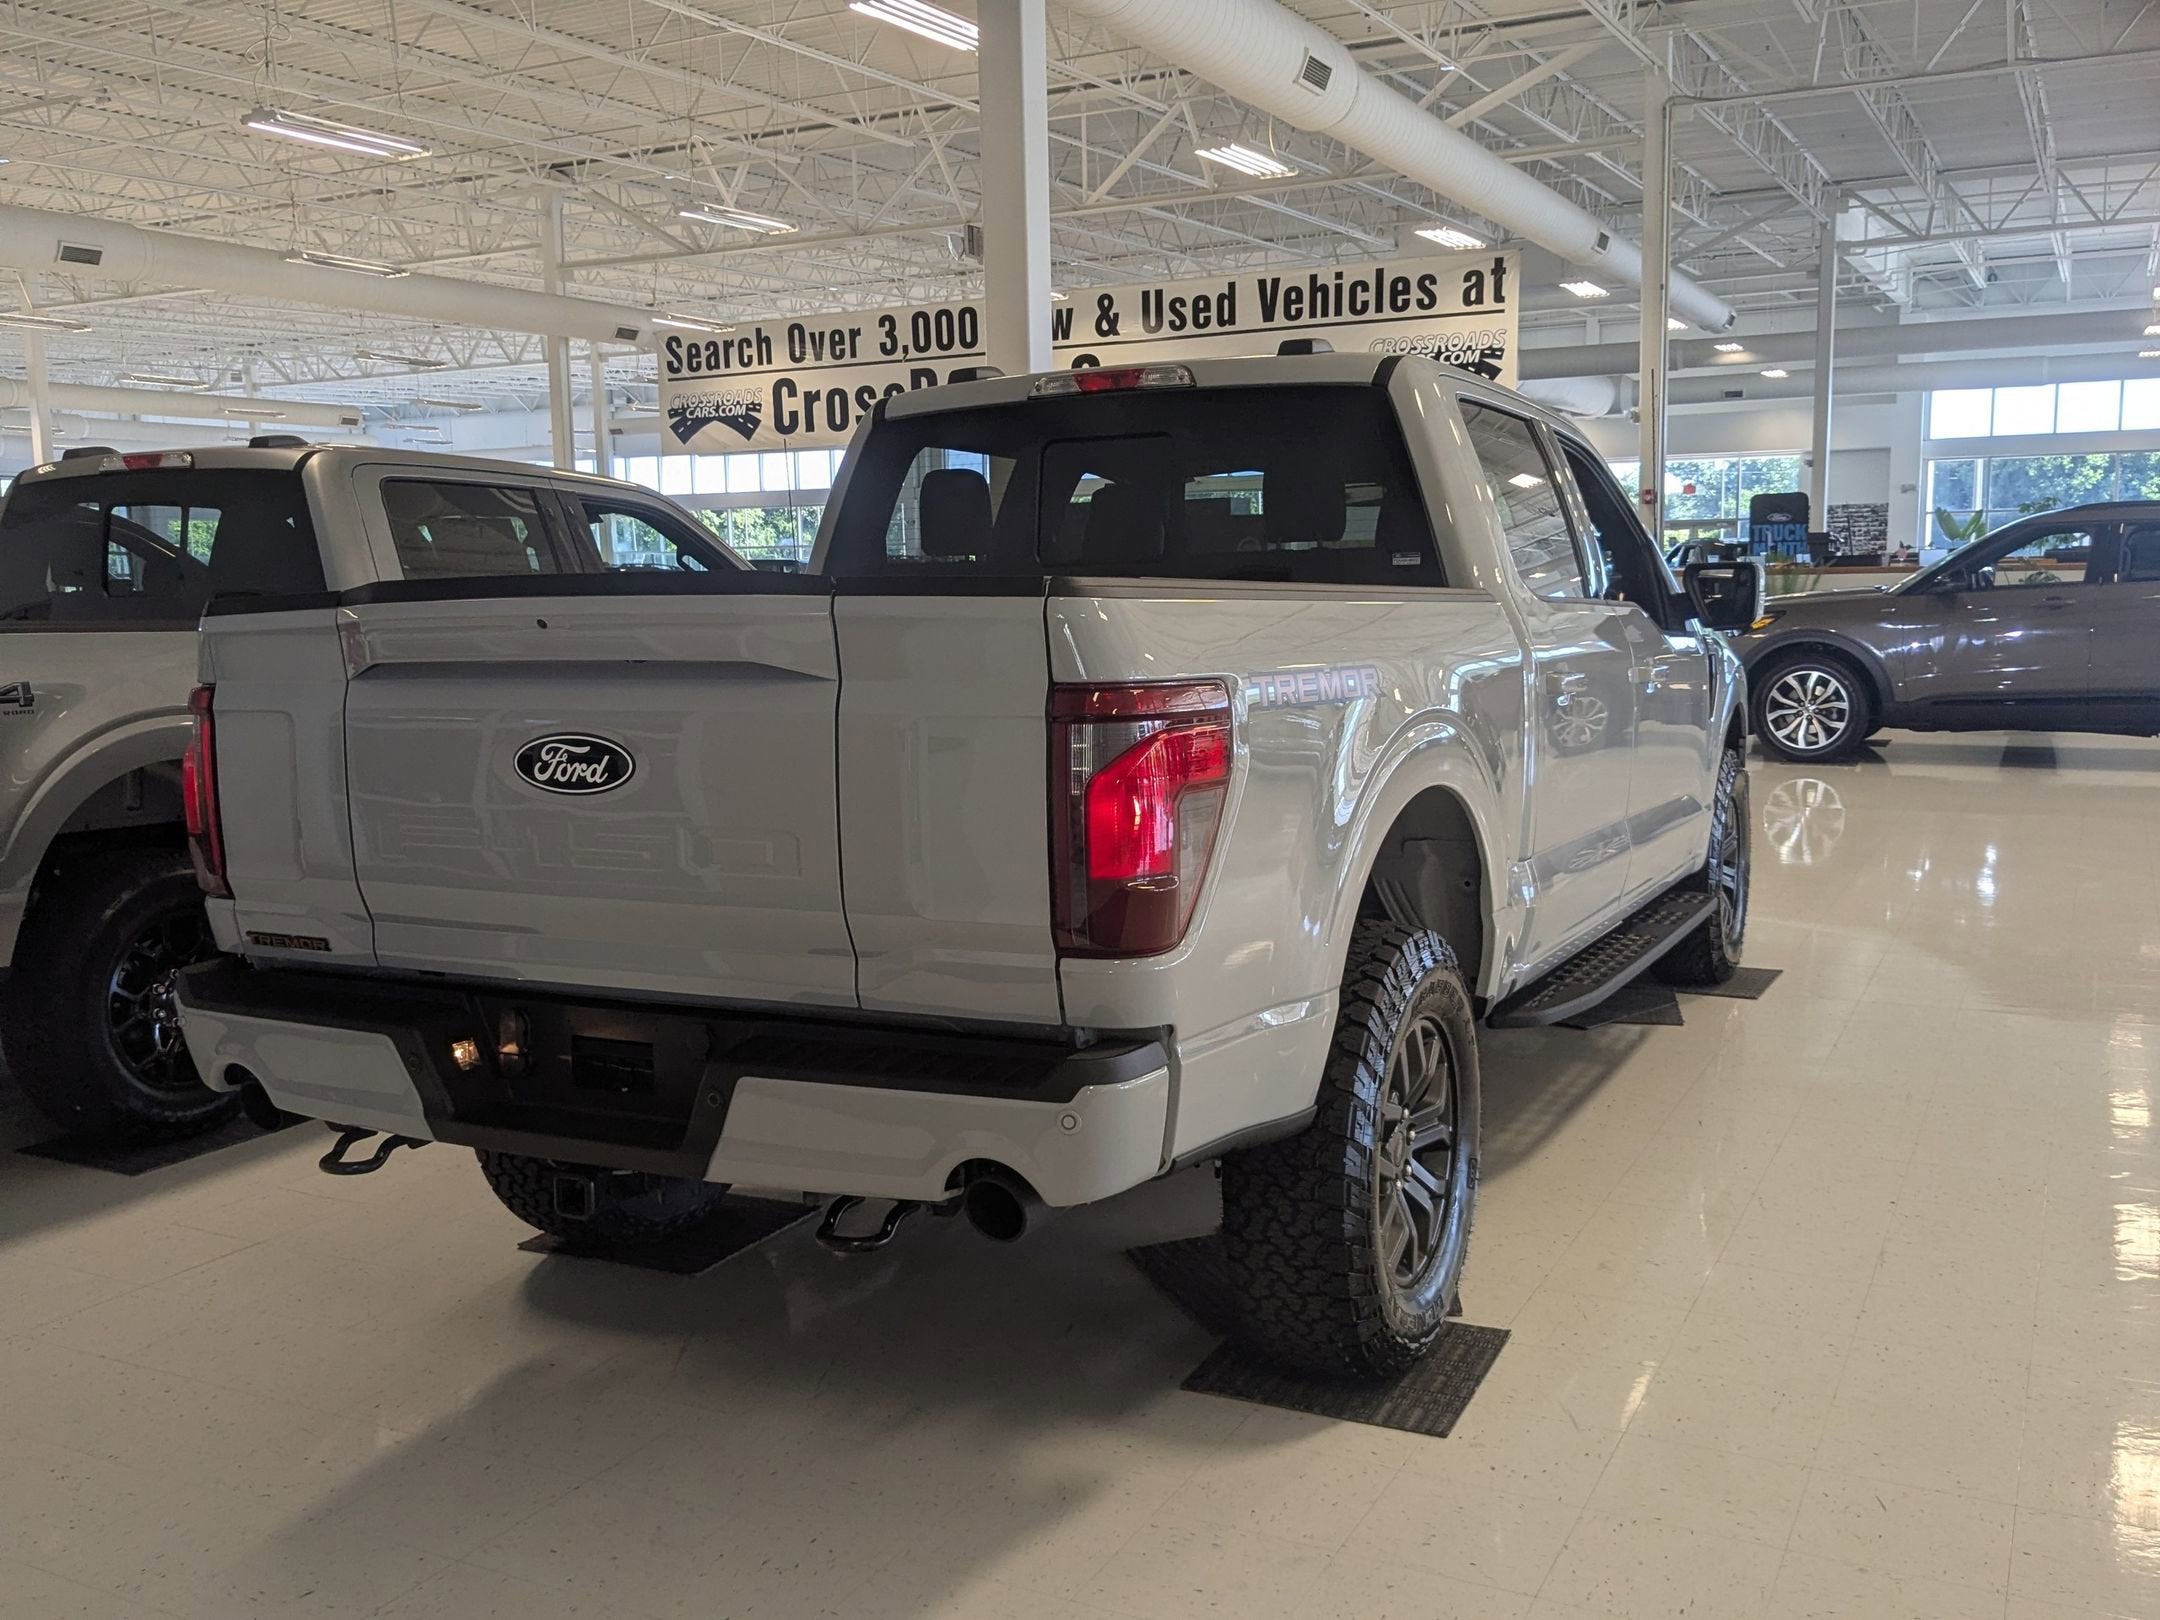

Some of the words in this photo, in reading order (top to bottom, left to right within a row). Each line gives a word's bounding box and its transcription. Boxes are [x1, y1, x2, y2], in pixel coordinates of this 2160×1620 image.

[666, 326, 773, 375] Search
[787, 322, 861, 365] Over
[878, 306, 979, 364] 3,000
[1094, 293, 1120, 338] &
[1141, 281, 1236, 334] Used
[1257, 267, 1438, 324] Vehicles
[1462, 257, 1506, 306] at
[1369, 329, 1507, 355] CROSSROADS
[670, 387, 763, 410] CROSSROADS
[686, 404, 747, 419] CARS.COM
[1751, 523, 1808, 541] TRUCK
[1752, 541, 1809, 557] MNTH
[1250, 667, 1382, 708] TREMOR
[534, 743, 610, 784] Ford
[247, 931, 331, 952] TREMOR
